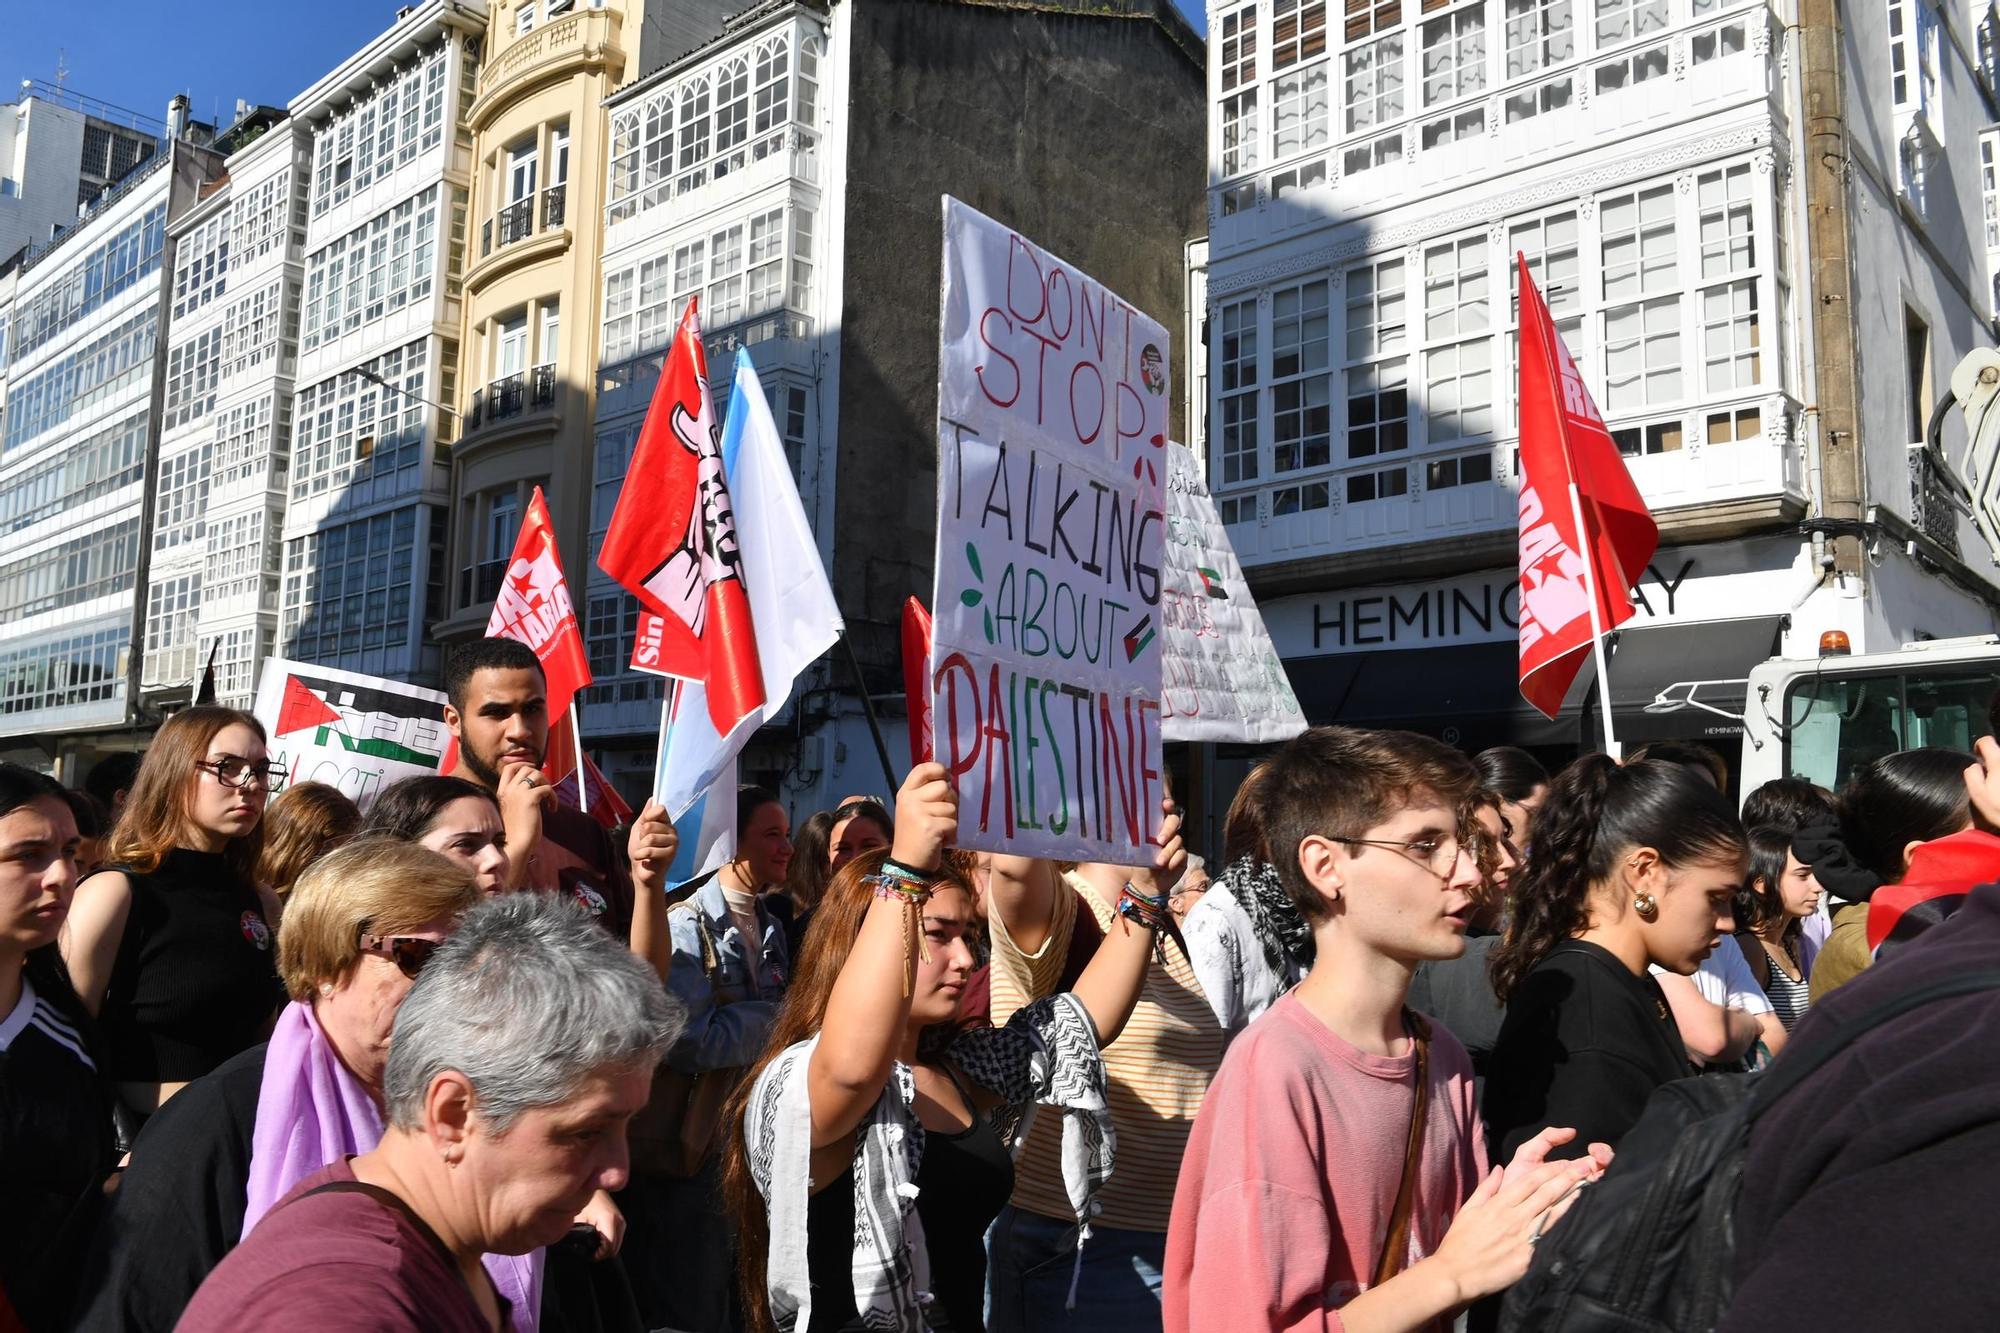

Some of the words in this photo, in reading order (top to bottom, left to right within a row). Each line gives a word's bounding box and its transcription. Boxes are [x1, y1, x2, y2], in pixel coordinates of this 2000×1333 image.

[1007, 233, 1138, 382] DON'T
[974, 306, 1146, 461] STOP
[940, 416, 1164, 606] TALKING
[637, 616, 665, 665] Sin
[995, 562, 1130, 669] ABOUT
[1313, 559, 1696, 649] HEMINY
[933, 652, 1162, 848] PALESTINE
